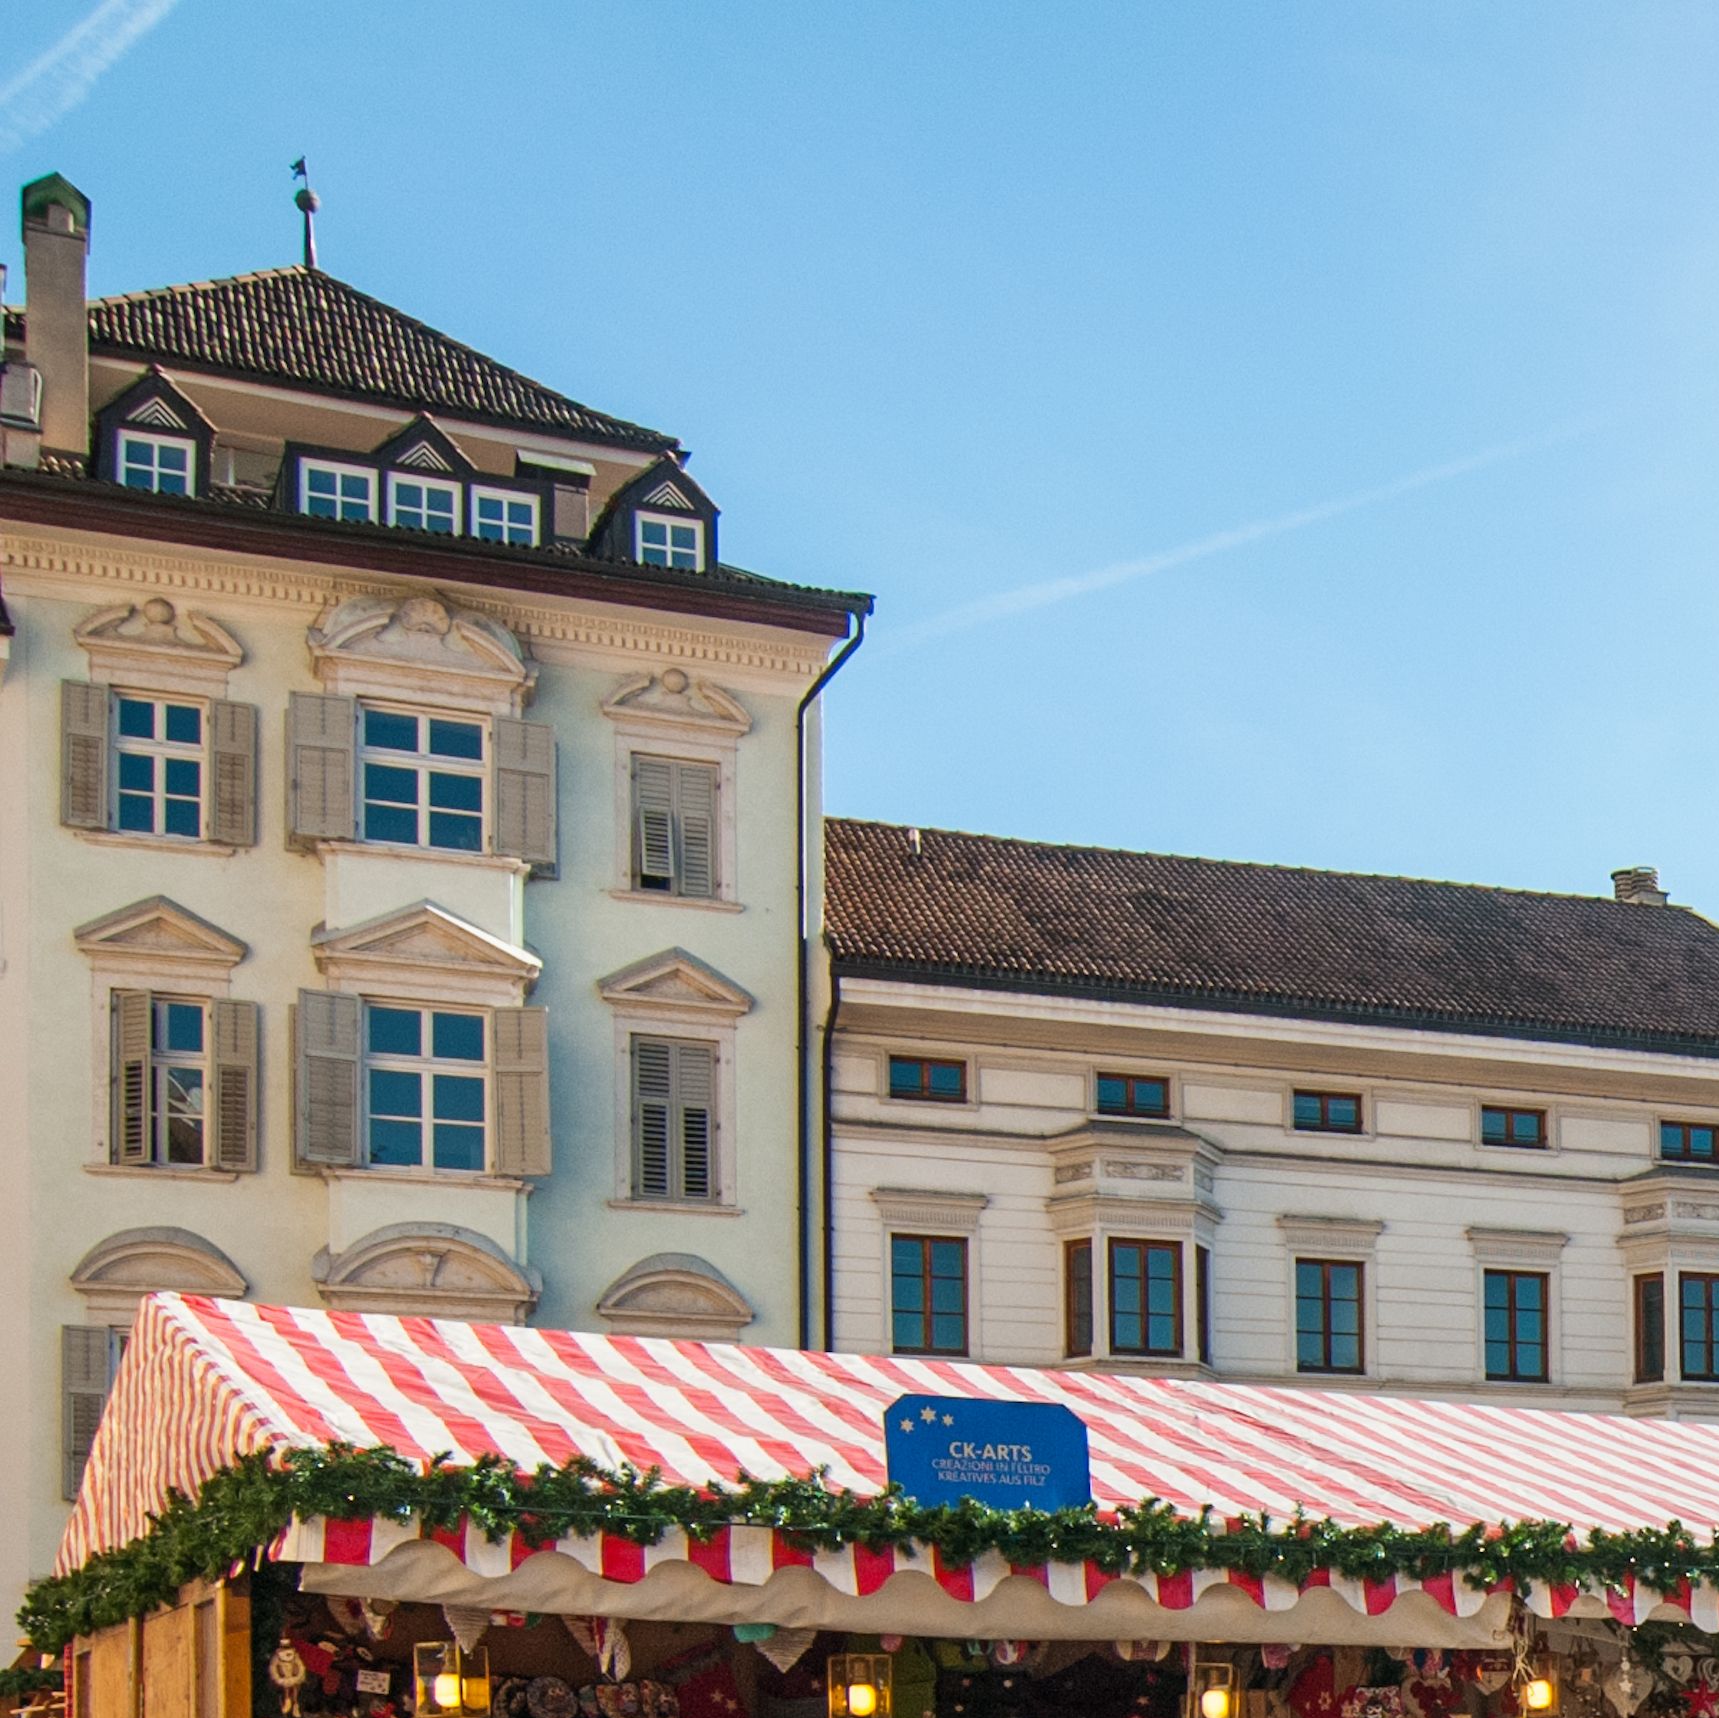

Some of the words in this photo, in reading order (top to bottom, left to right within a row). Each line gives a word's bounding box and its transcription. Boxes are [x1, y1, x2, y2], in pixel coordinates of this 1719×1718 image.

[949, 1441, 1033, 1462] CK-ARTS
[931, 1458, 994, 1472] CREAZIONI
[938, 1471, 996, 1484] KREATIVES
[998, 1473, 1021, 1485] AUS
[1024, 1474, 1046, 1487] FILZ
